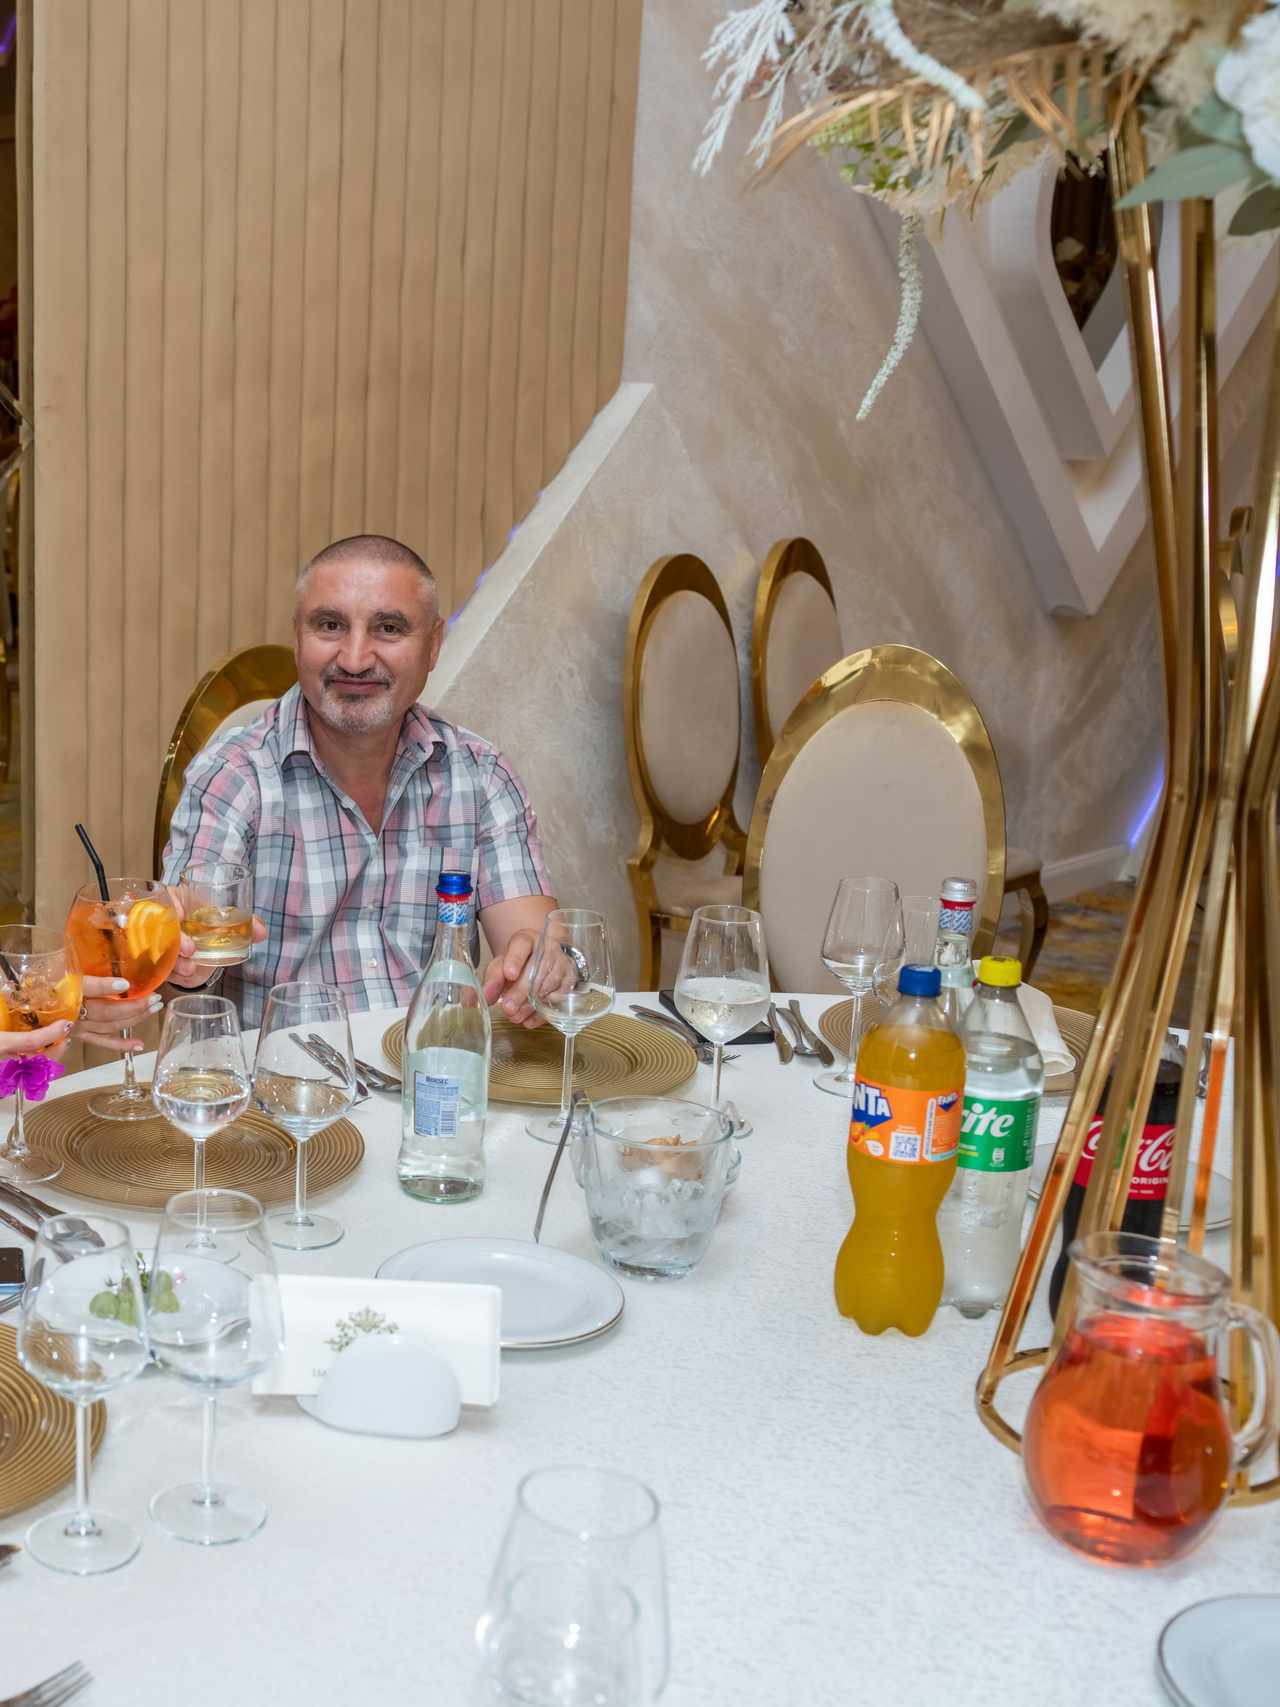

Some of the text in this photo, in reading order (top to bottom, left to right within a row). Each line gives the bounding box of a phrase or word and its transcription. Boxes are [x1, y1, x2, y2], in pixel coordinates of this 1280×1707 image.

[426, 1076, 449, 1085] BORSEC
[853, 1083, 891, 1117] NTA
[1131, 1176, 1169, 1185] ORIGIN
